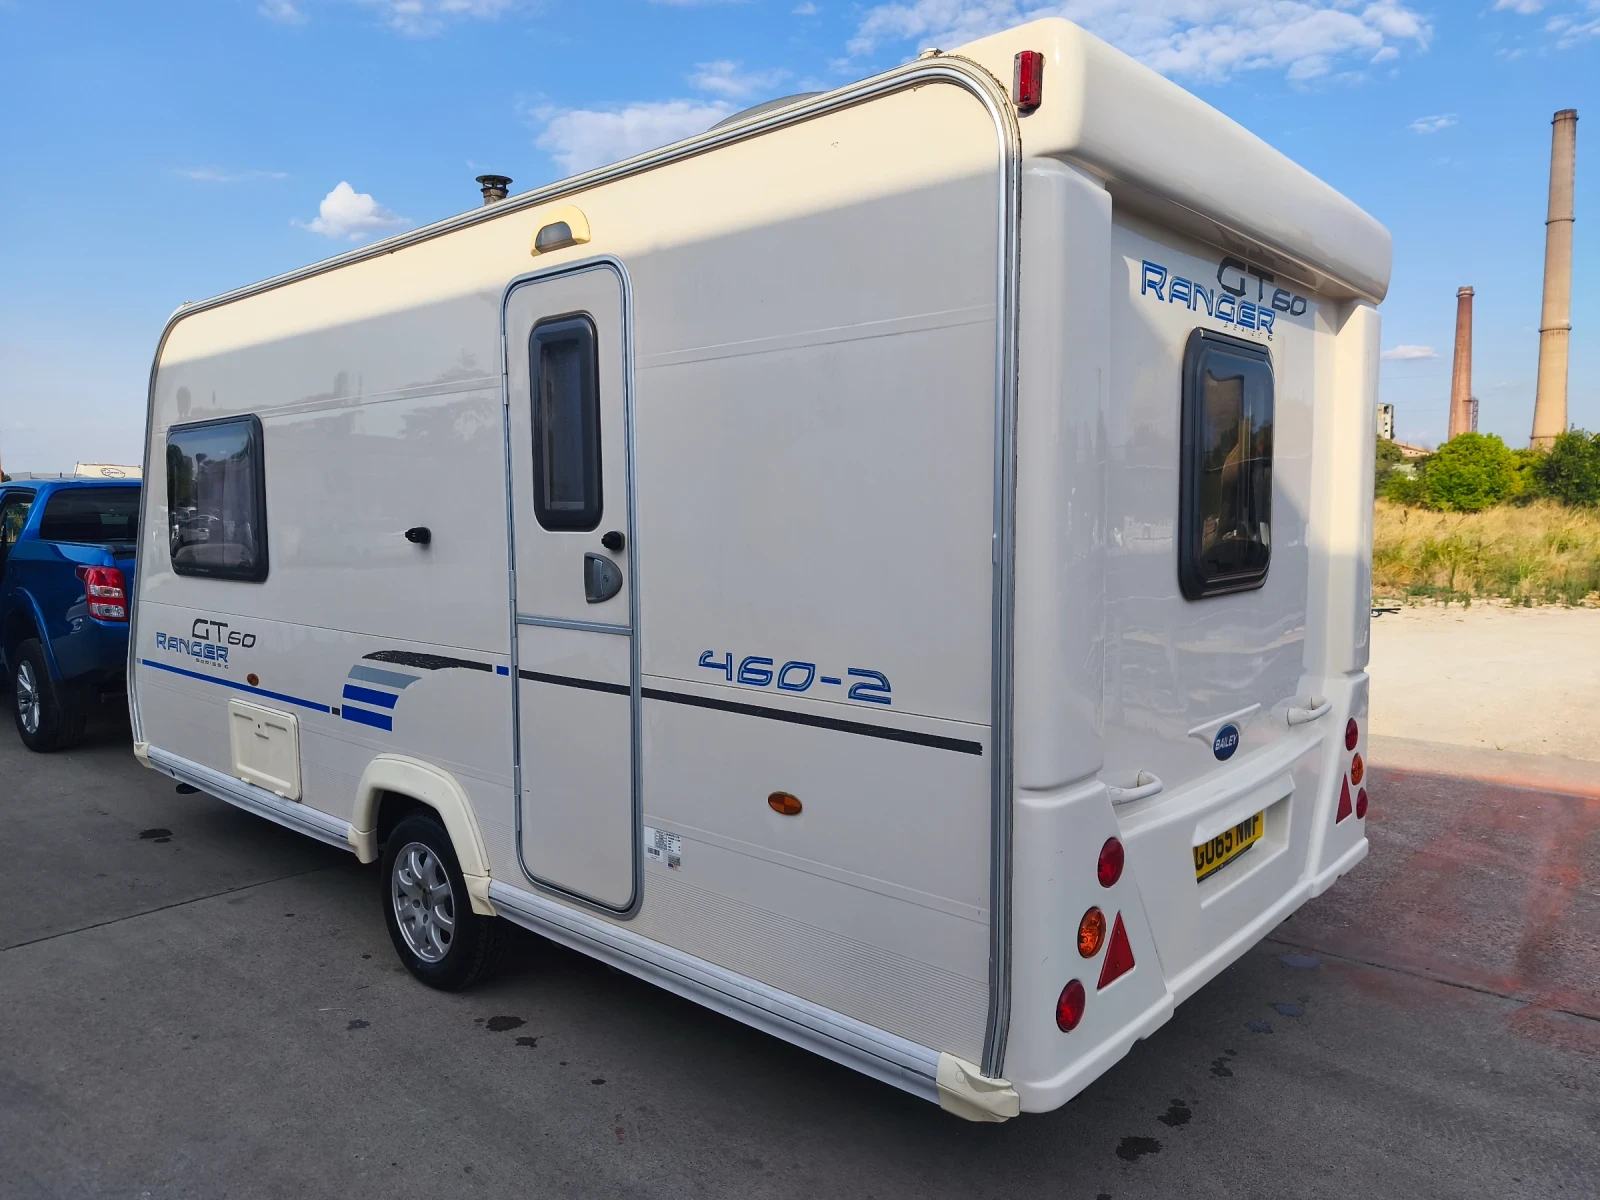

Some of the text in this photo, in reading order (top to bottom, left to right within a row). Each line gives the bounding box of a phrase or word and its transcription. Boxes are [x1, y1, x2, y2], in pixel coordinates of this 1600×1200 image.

[1141, 259, 1275, 335] RANGER
[156, 631, 228, 663] RANGER
[698, 649, 892, 706] 460-2
[1214, 733, 1238, 751] BAILEY
